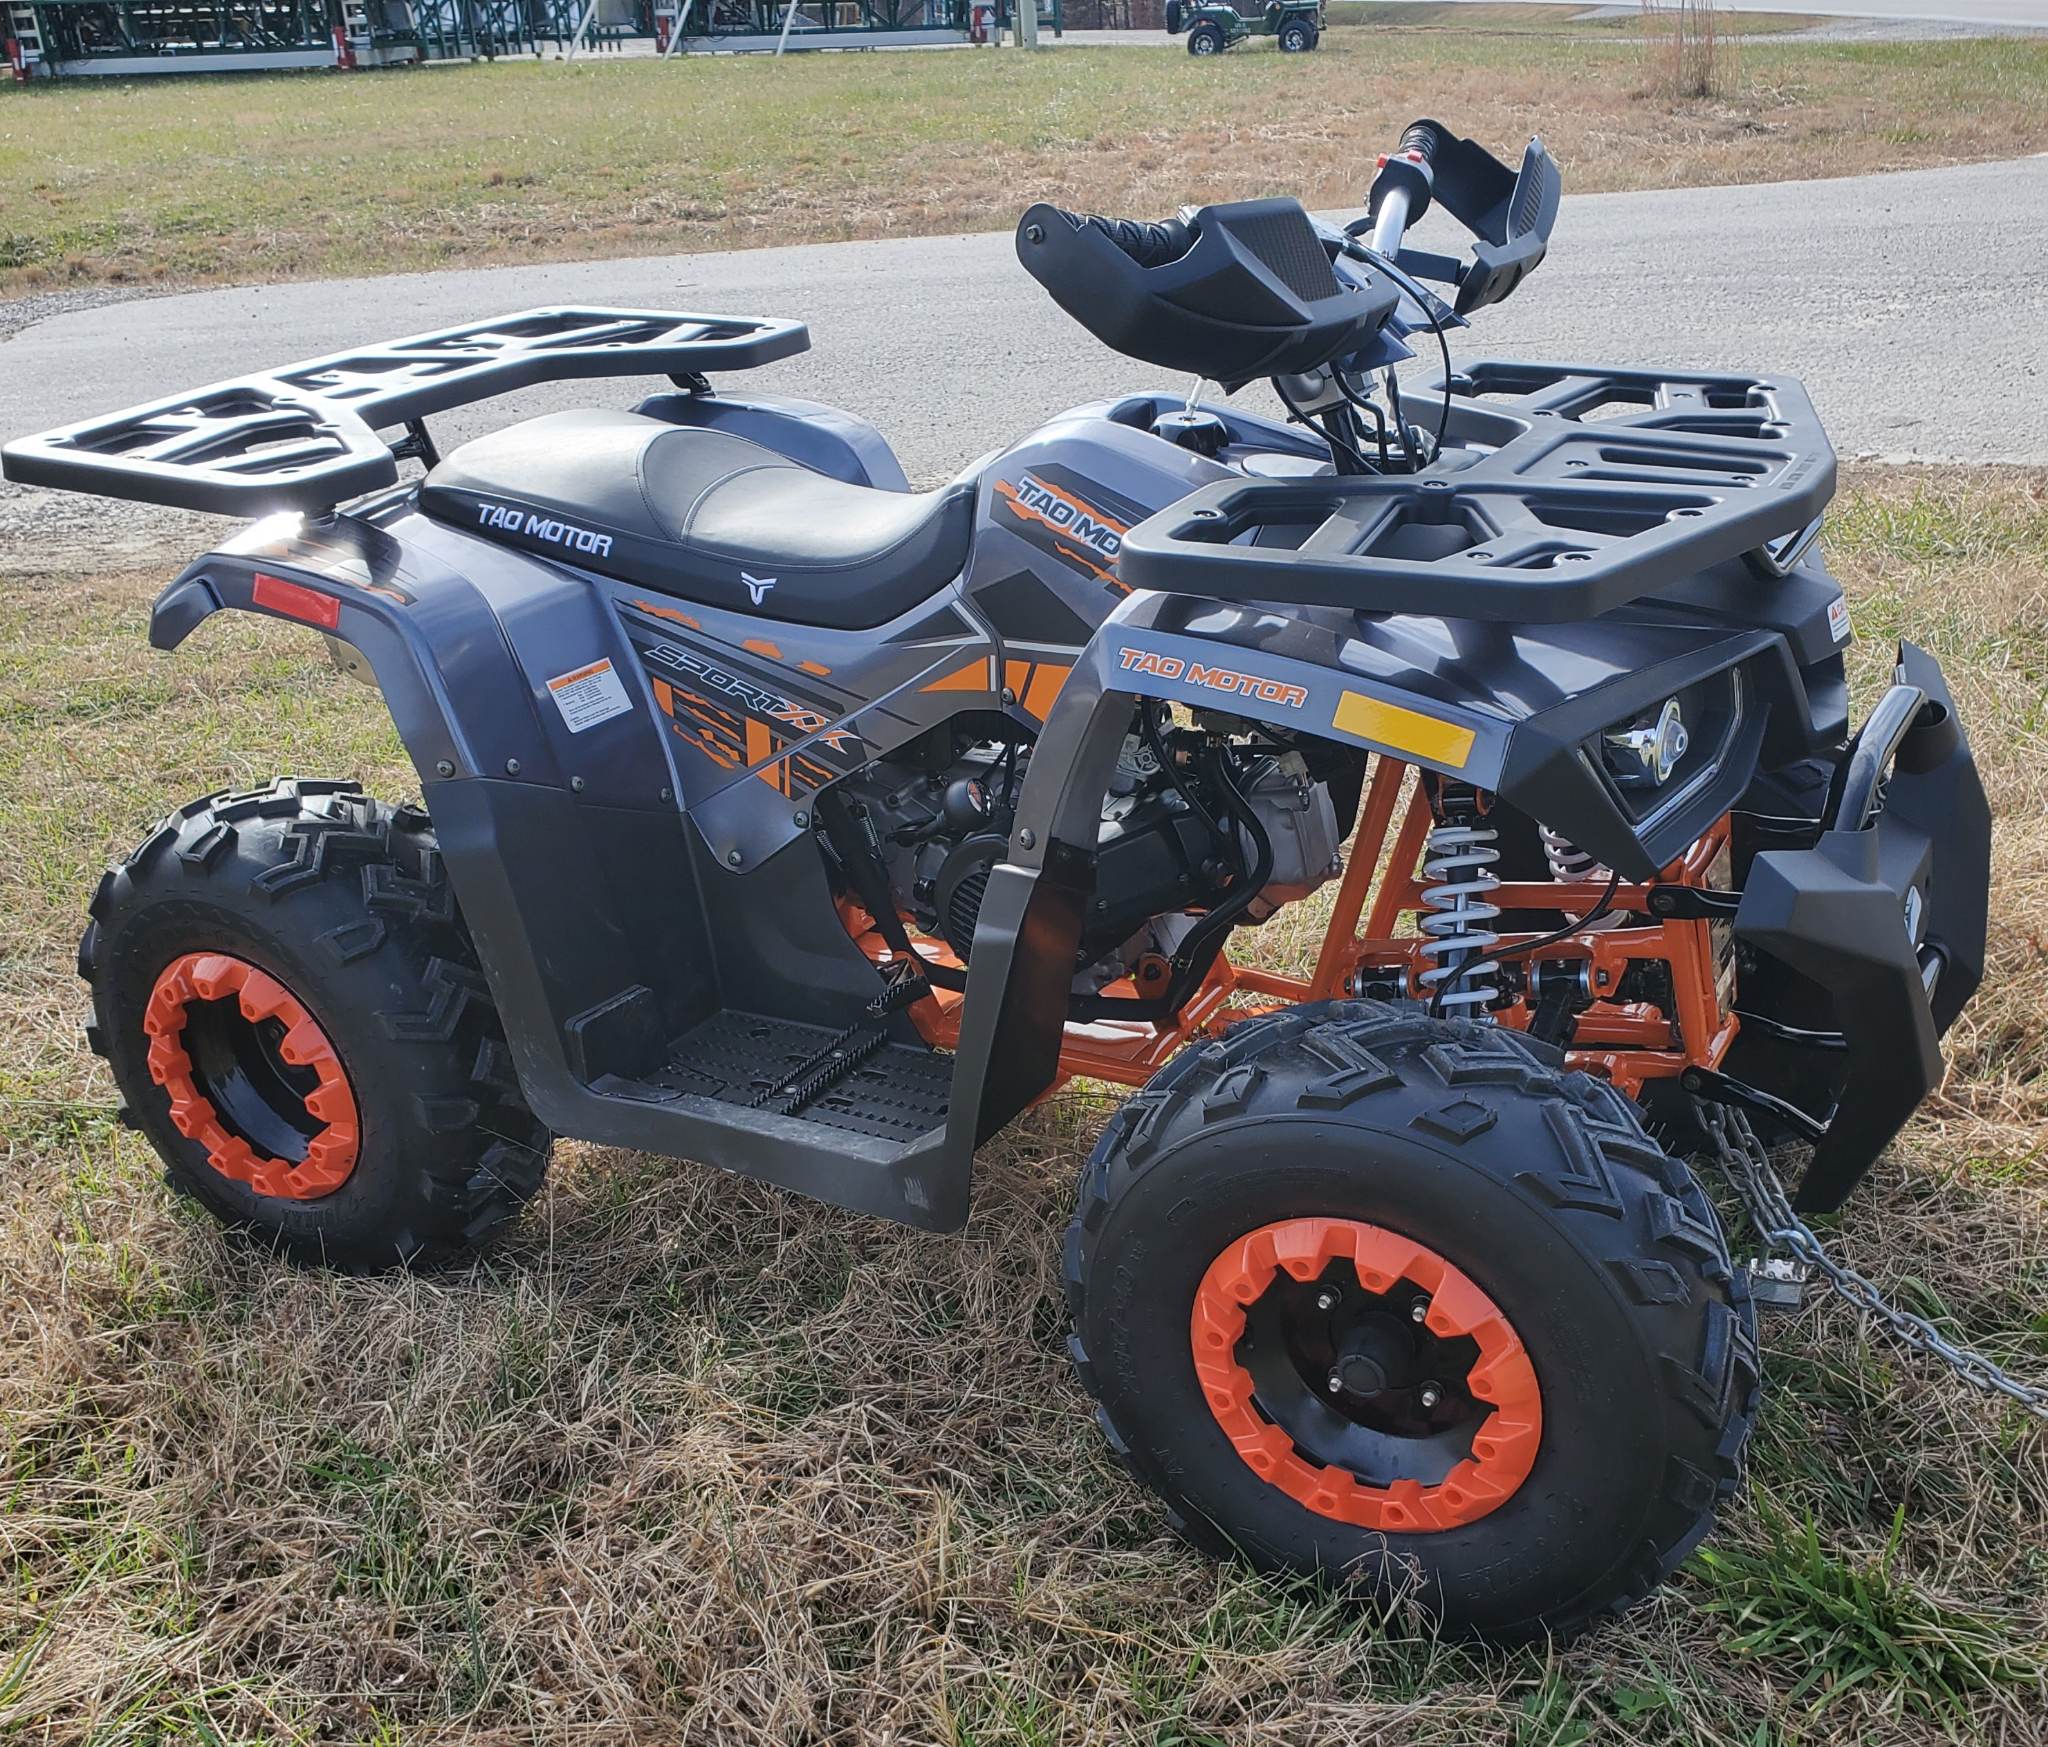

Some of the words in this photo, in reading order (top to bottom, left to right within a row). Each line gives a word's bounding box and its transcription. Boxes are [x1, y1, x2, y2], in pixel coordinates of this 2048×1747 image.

[478, 503, 523, 531] TAO
[524, 514, 613, 558] MOTOR
[1016, 476, 1077, 528] TAO
[1071, 513, 1121, 558] MO
[1119, 647, 1185, 679] TAO
[1184, 663, 1309, 709] MOTOR
